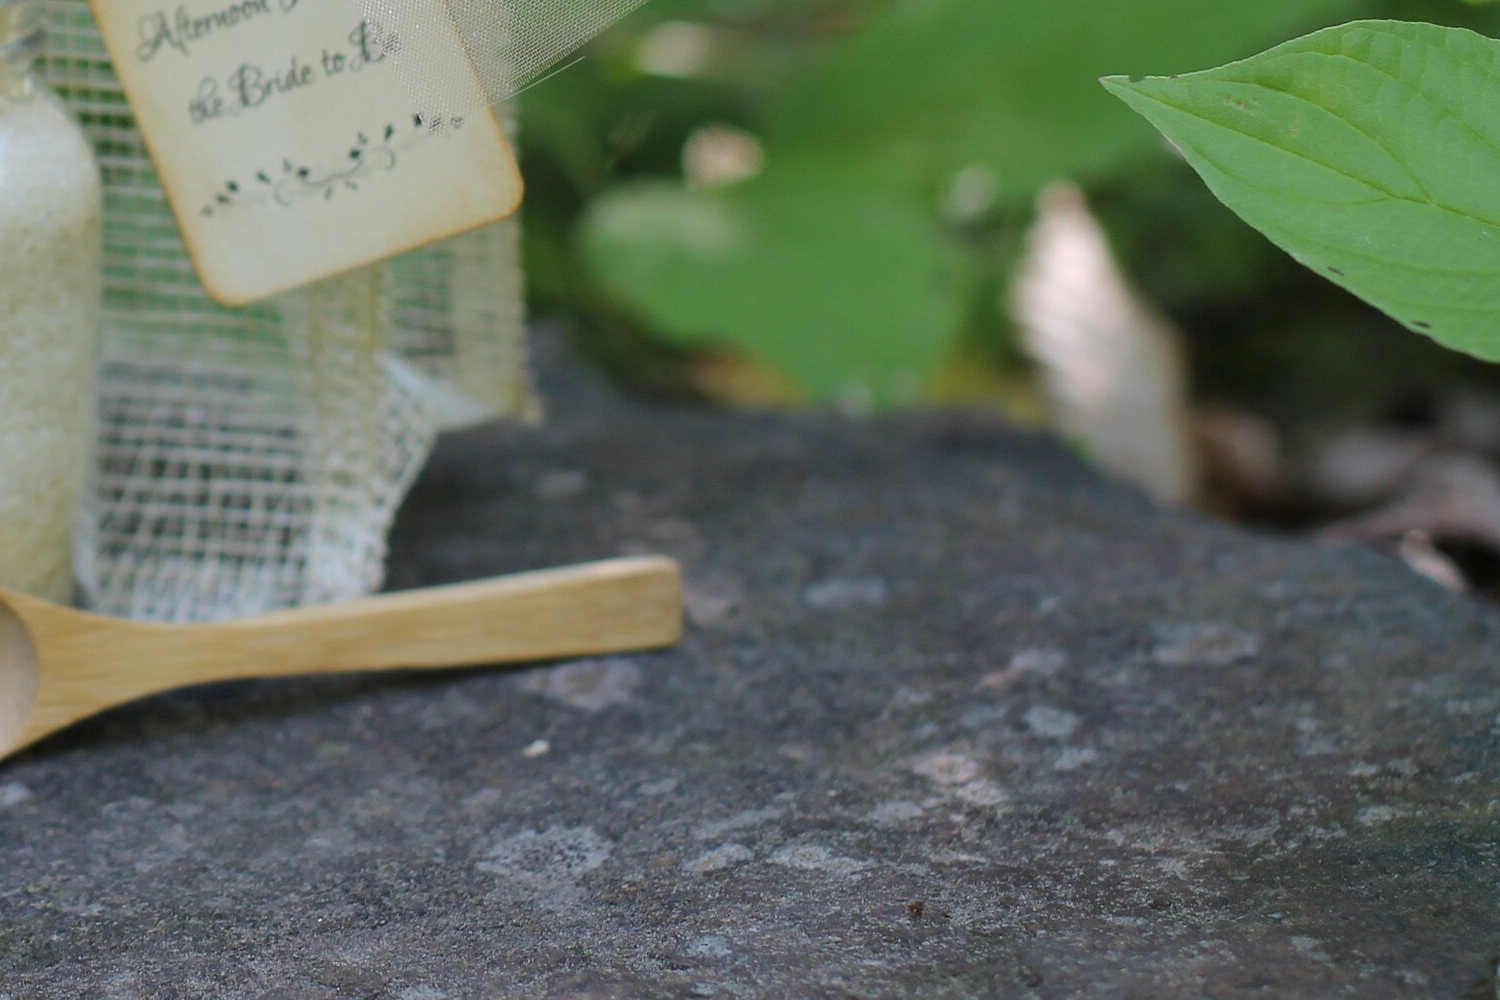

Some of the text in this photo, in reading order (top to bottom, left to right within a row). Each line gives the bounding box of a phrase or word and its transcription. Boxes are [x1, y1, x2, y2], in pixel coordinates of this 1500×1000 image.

[188, 76, 224, 126] the
[227, 55, 313, 116] Bride
[321, 49, 347, 76] to
